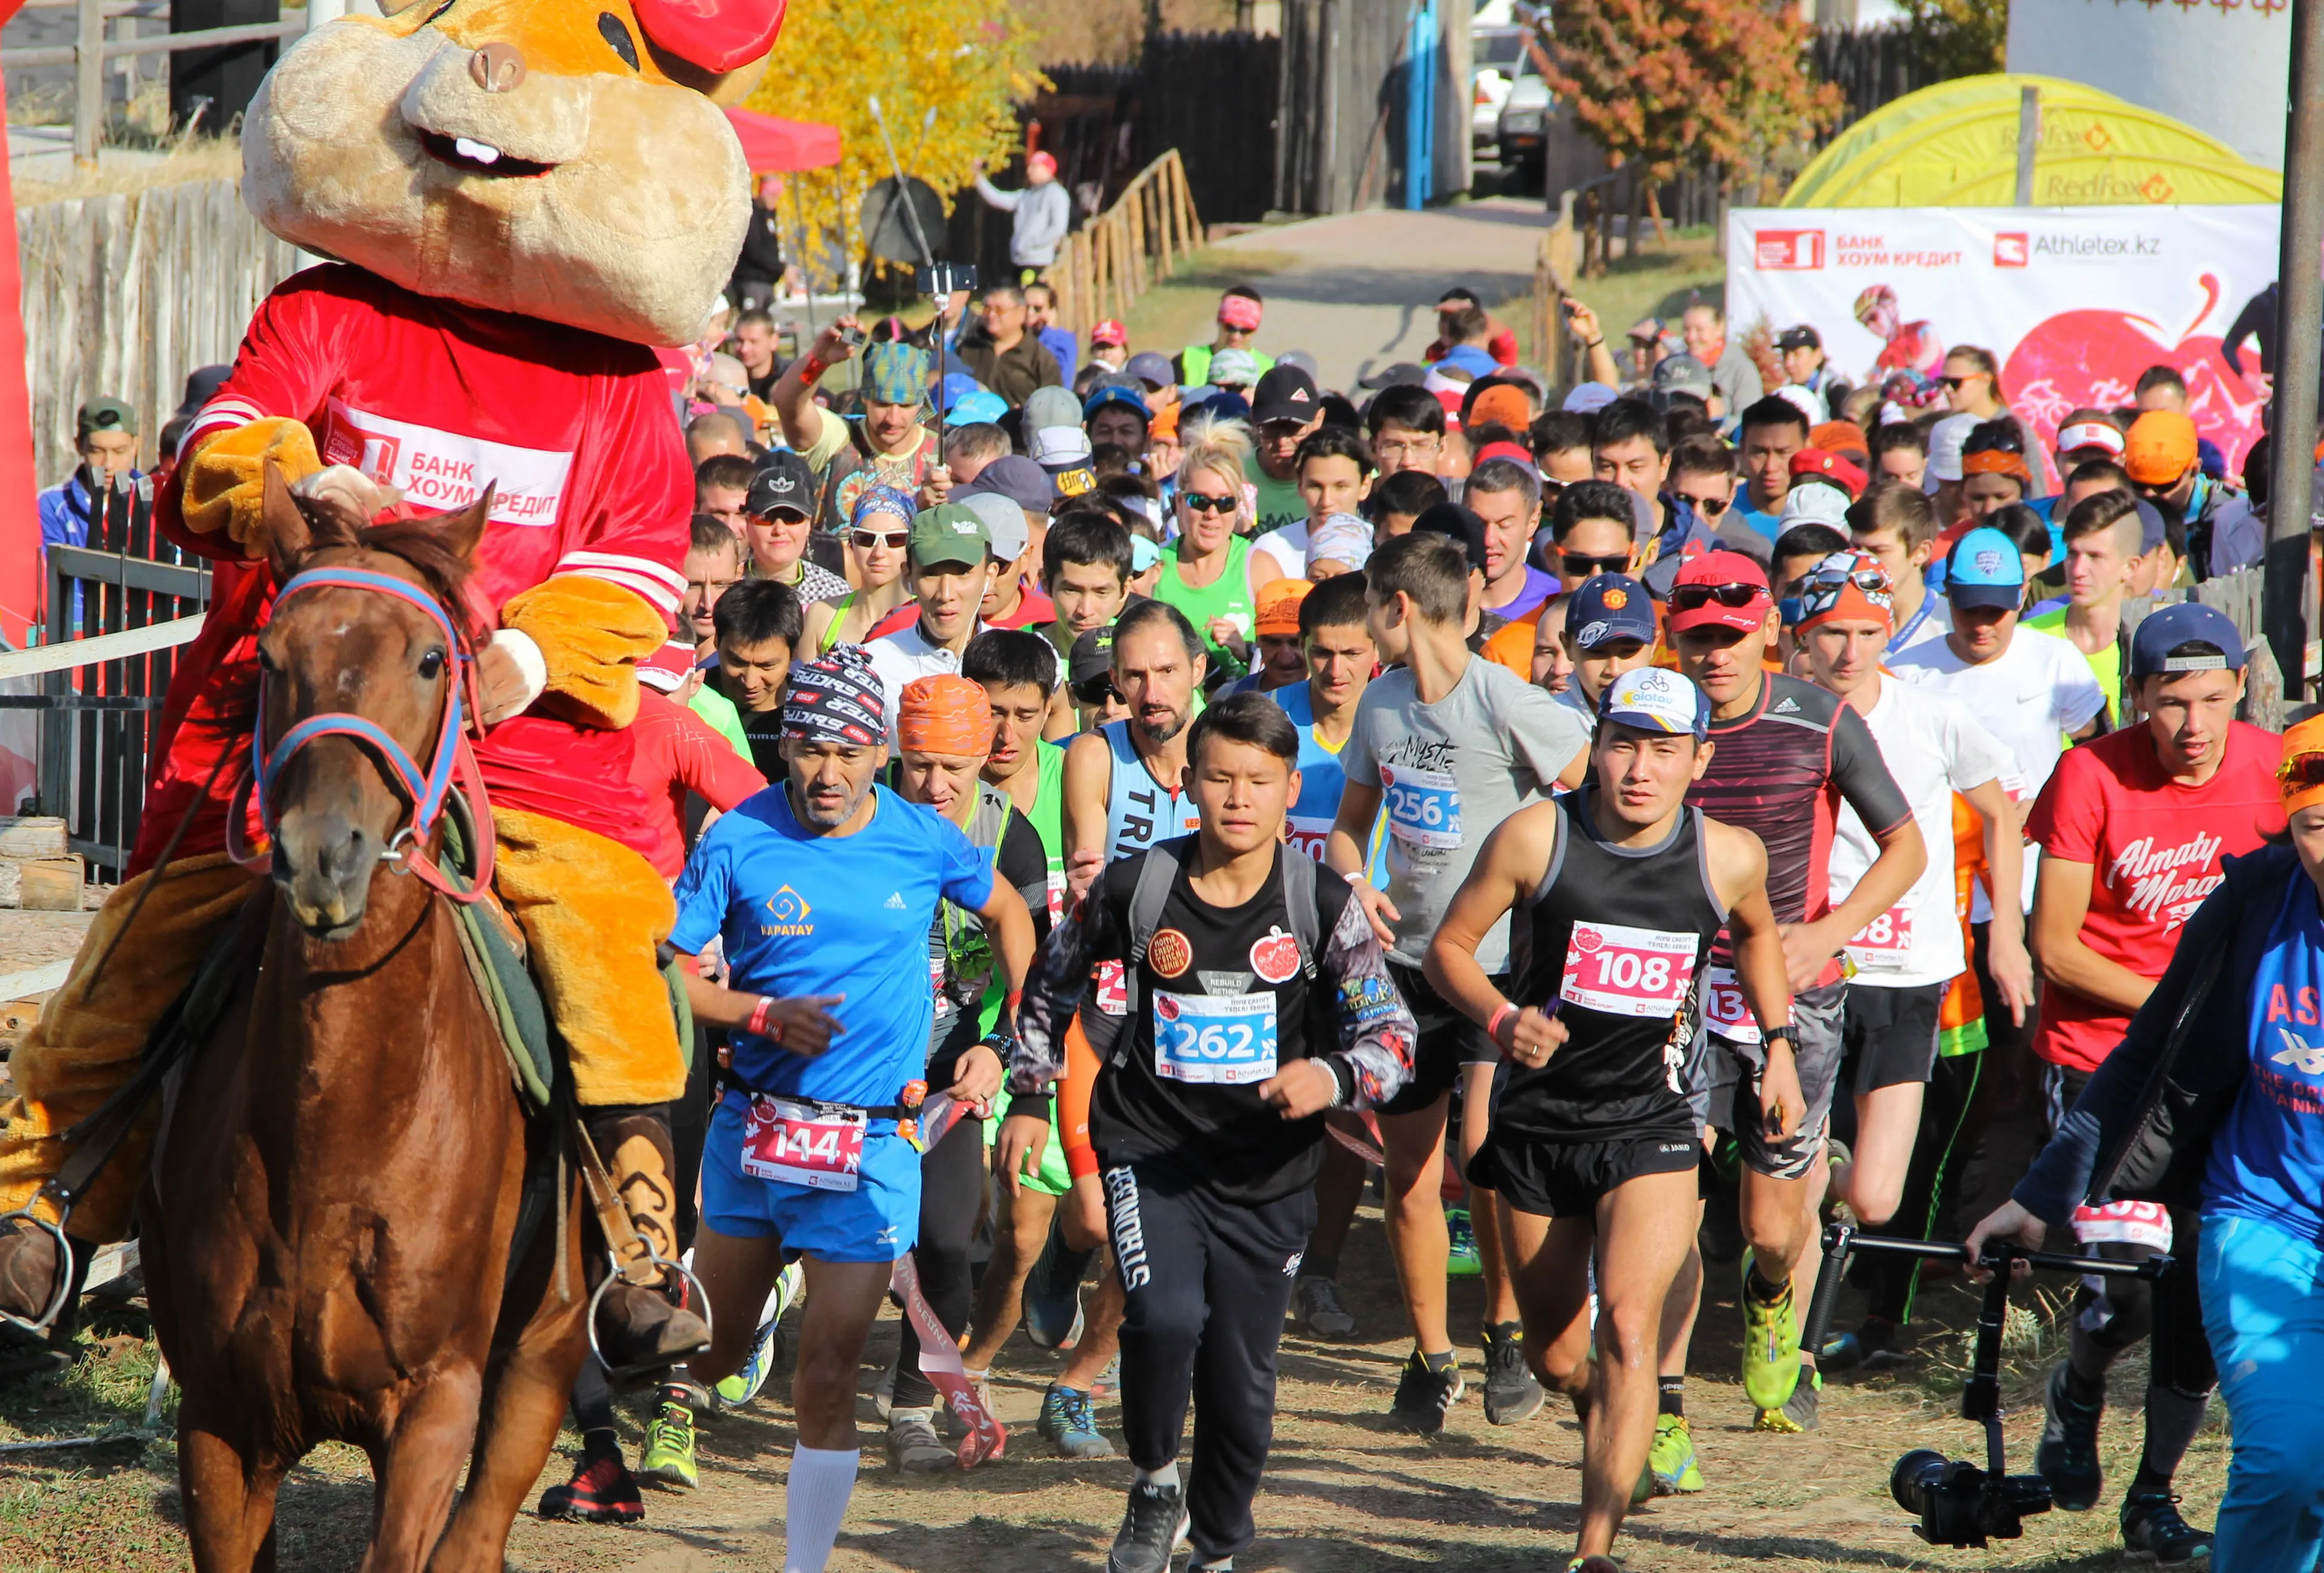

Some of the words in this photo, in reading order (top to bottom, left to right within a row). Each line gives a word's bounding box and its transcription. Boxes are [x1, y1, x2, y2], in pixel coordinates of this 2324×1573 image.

[1836, 235, 1885, 250] БАНК
[2034, 234, 2161, 255] Athletex.kz
[1836, 252, 1889, 266] ХОУМ
[1894, 251, 1963, 268] КРЕДИТ
[328, 446, 352, 464] BANK
[330, 438, 359, 458] CREDIT
[410, 452, 476, 482] БАНК
[407, 473, 475, 505] ХОУМ
[1633, 691, 1673, 704] alatau
[1774, 705, 1802, 714] adidas
[1391, 788, 1443, 826] 256
[2107, 830, 2222, 889] Almaty
[1210, 979, 1242, 987] REBUILD
[1595, 951, 1671, 993] 108
[1175, 1022, 1255, 1059] 262
[2251, 1062, 2285, 1089] THE
[773, 1124, 841, 1165] 144
[1670, 1143, 1690, 1152] JAKO
[1106, 1165, 1152, 1292] STRONGER
